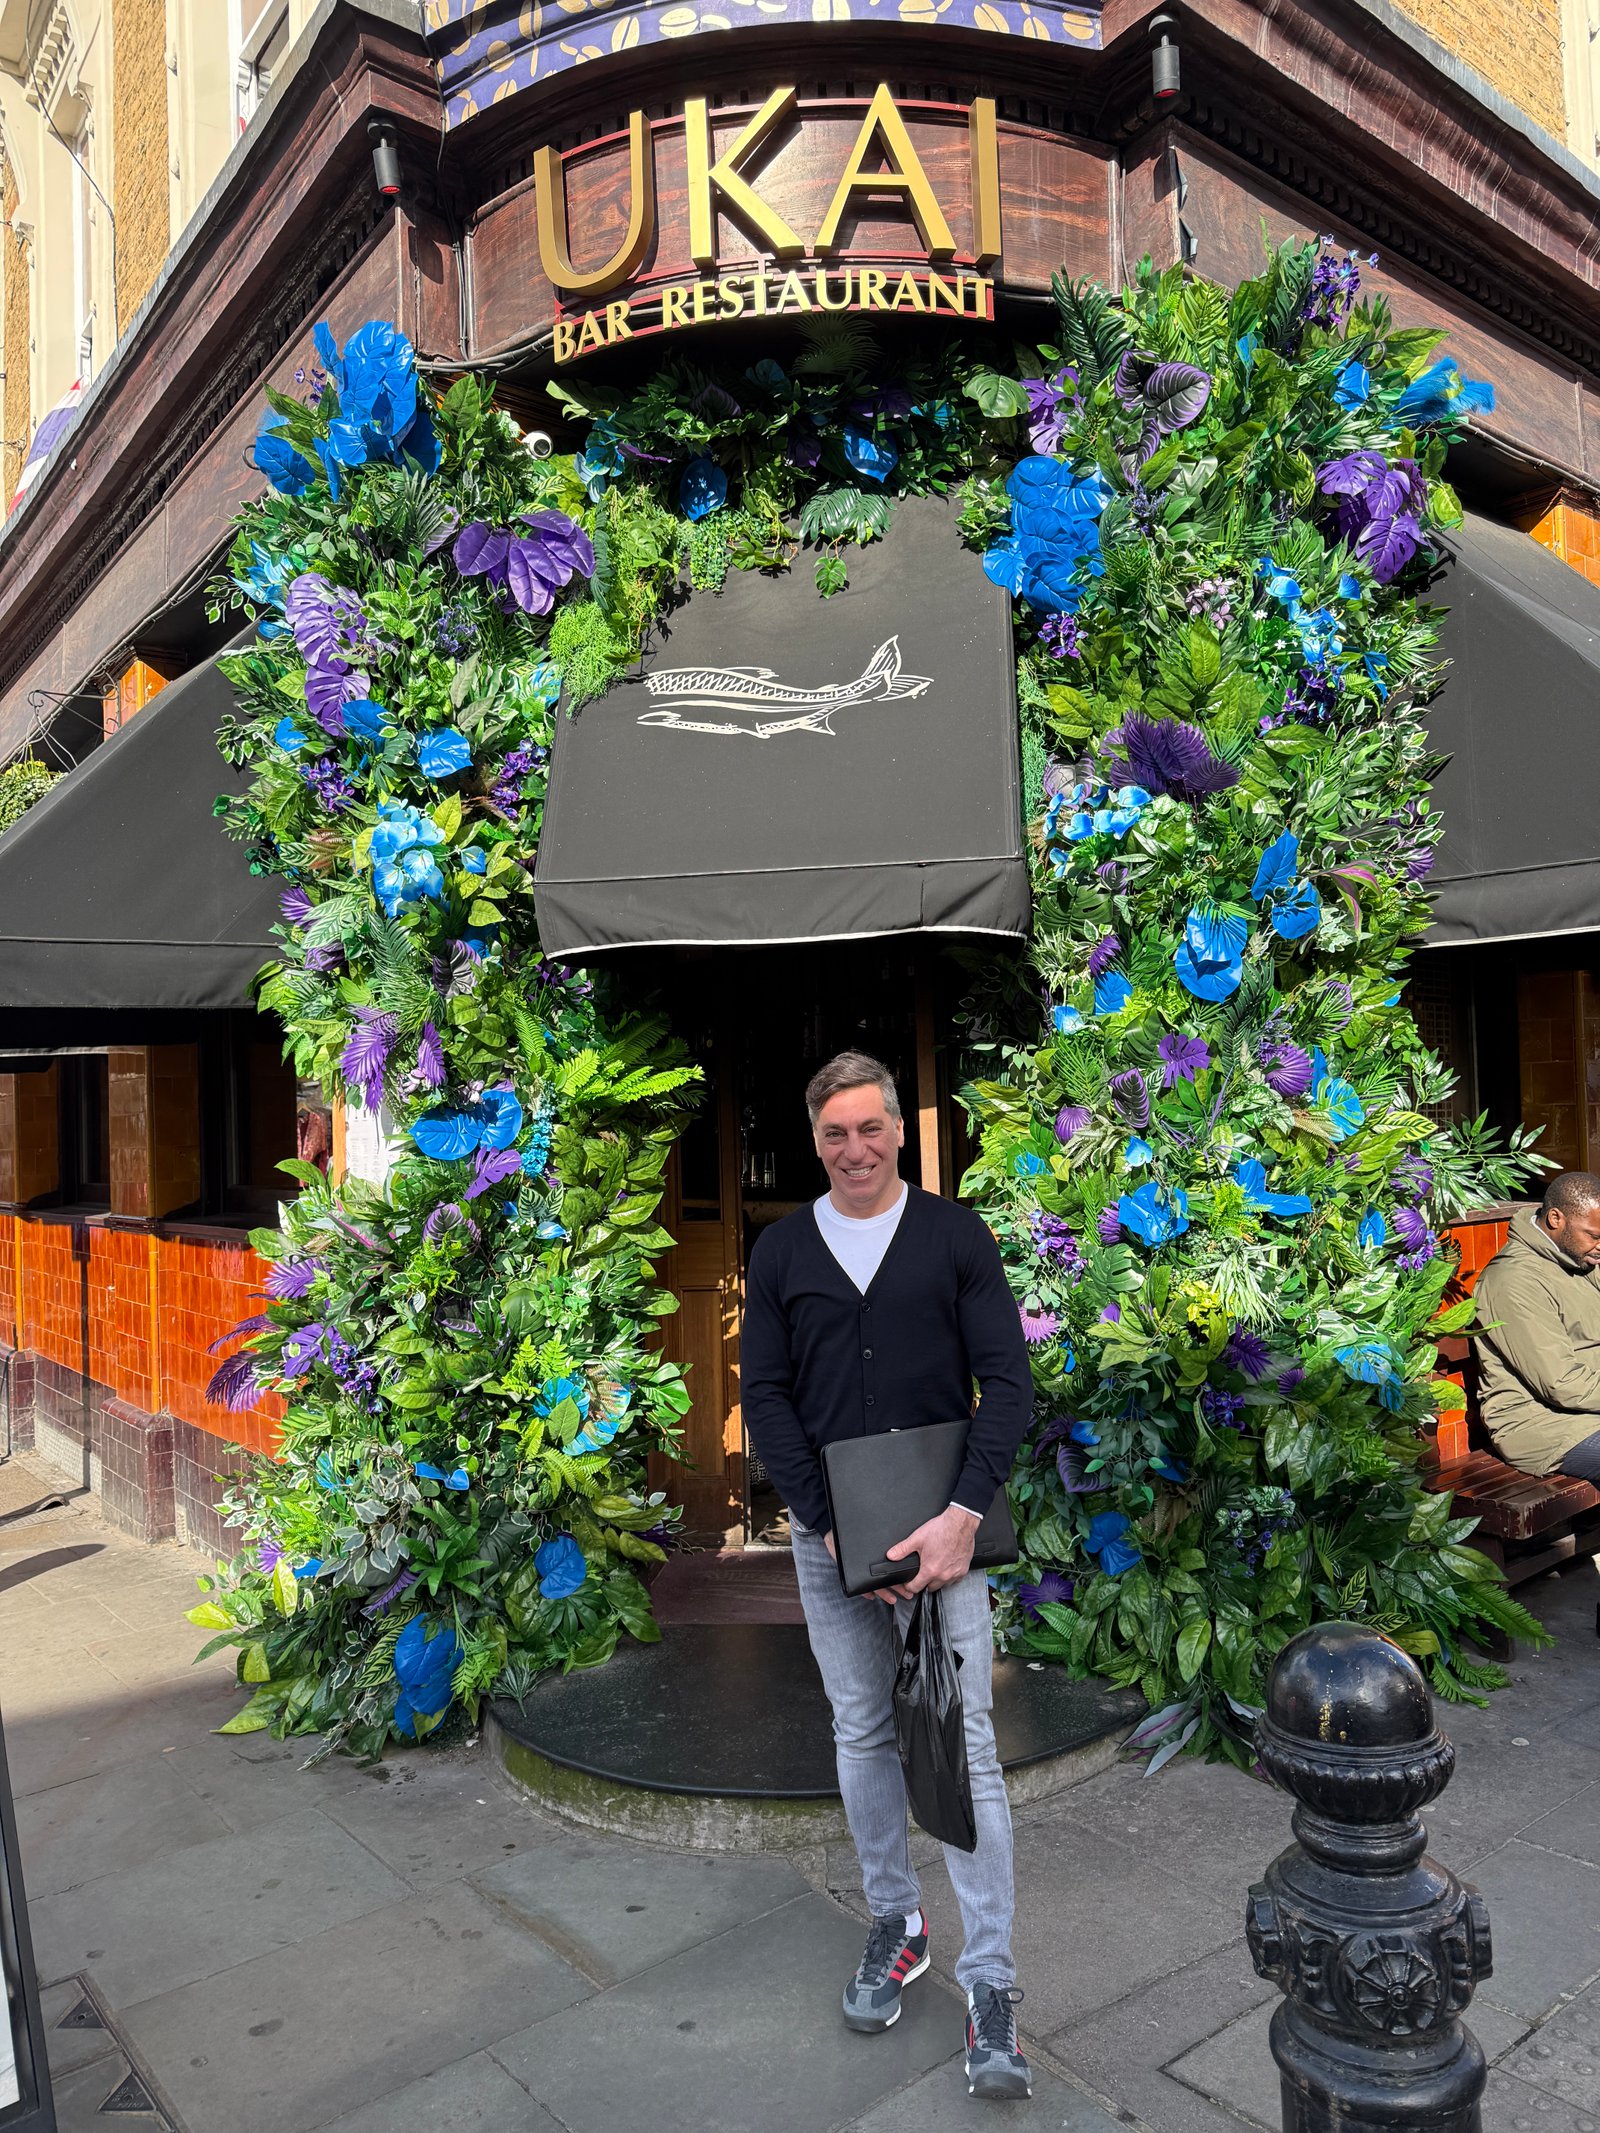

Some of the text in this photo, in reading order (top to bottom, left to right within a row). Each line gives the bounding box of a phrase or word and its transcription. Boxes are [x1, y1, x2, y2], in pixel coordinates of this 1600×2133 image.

[534, 83, 1001, 295] UKAI
[553, 269, 995, 365] BAR RESTAURANT
